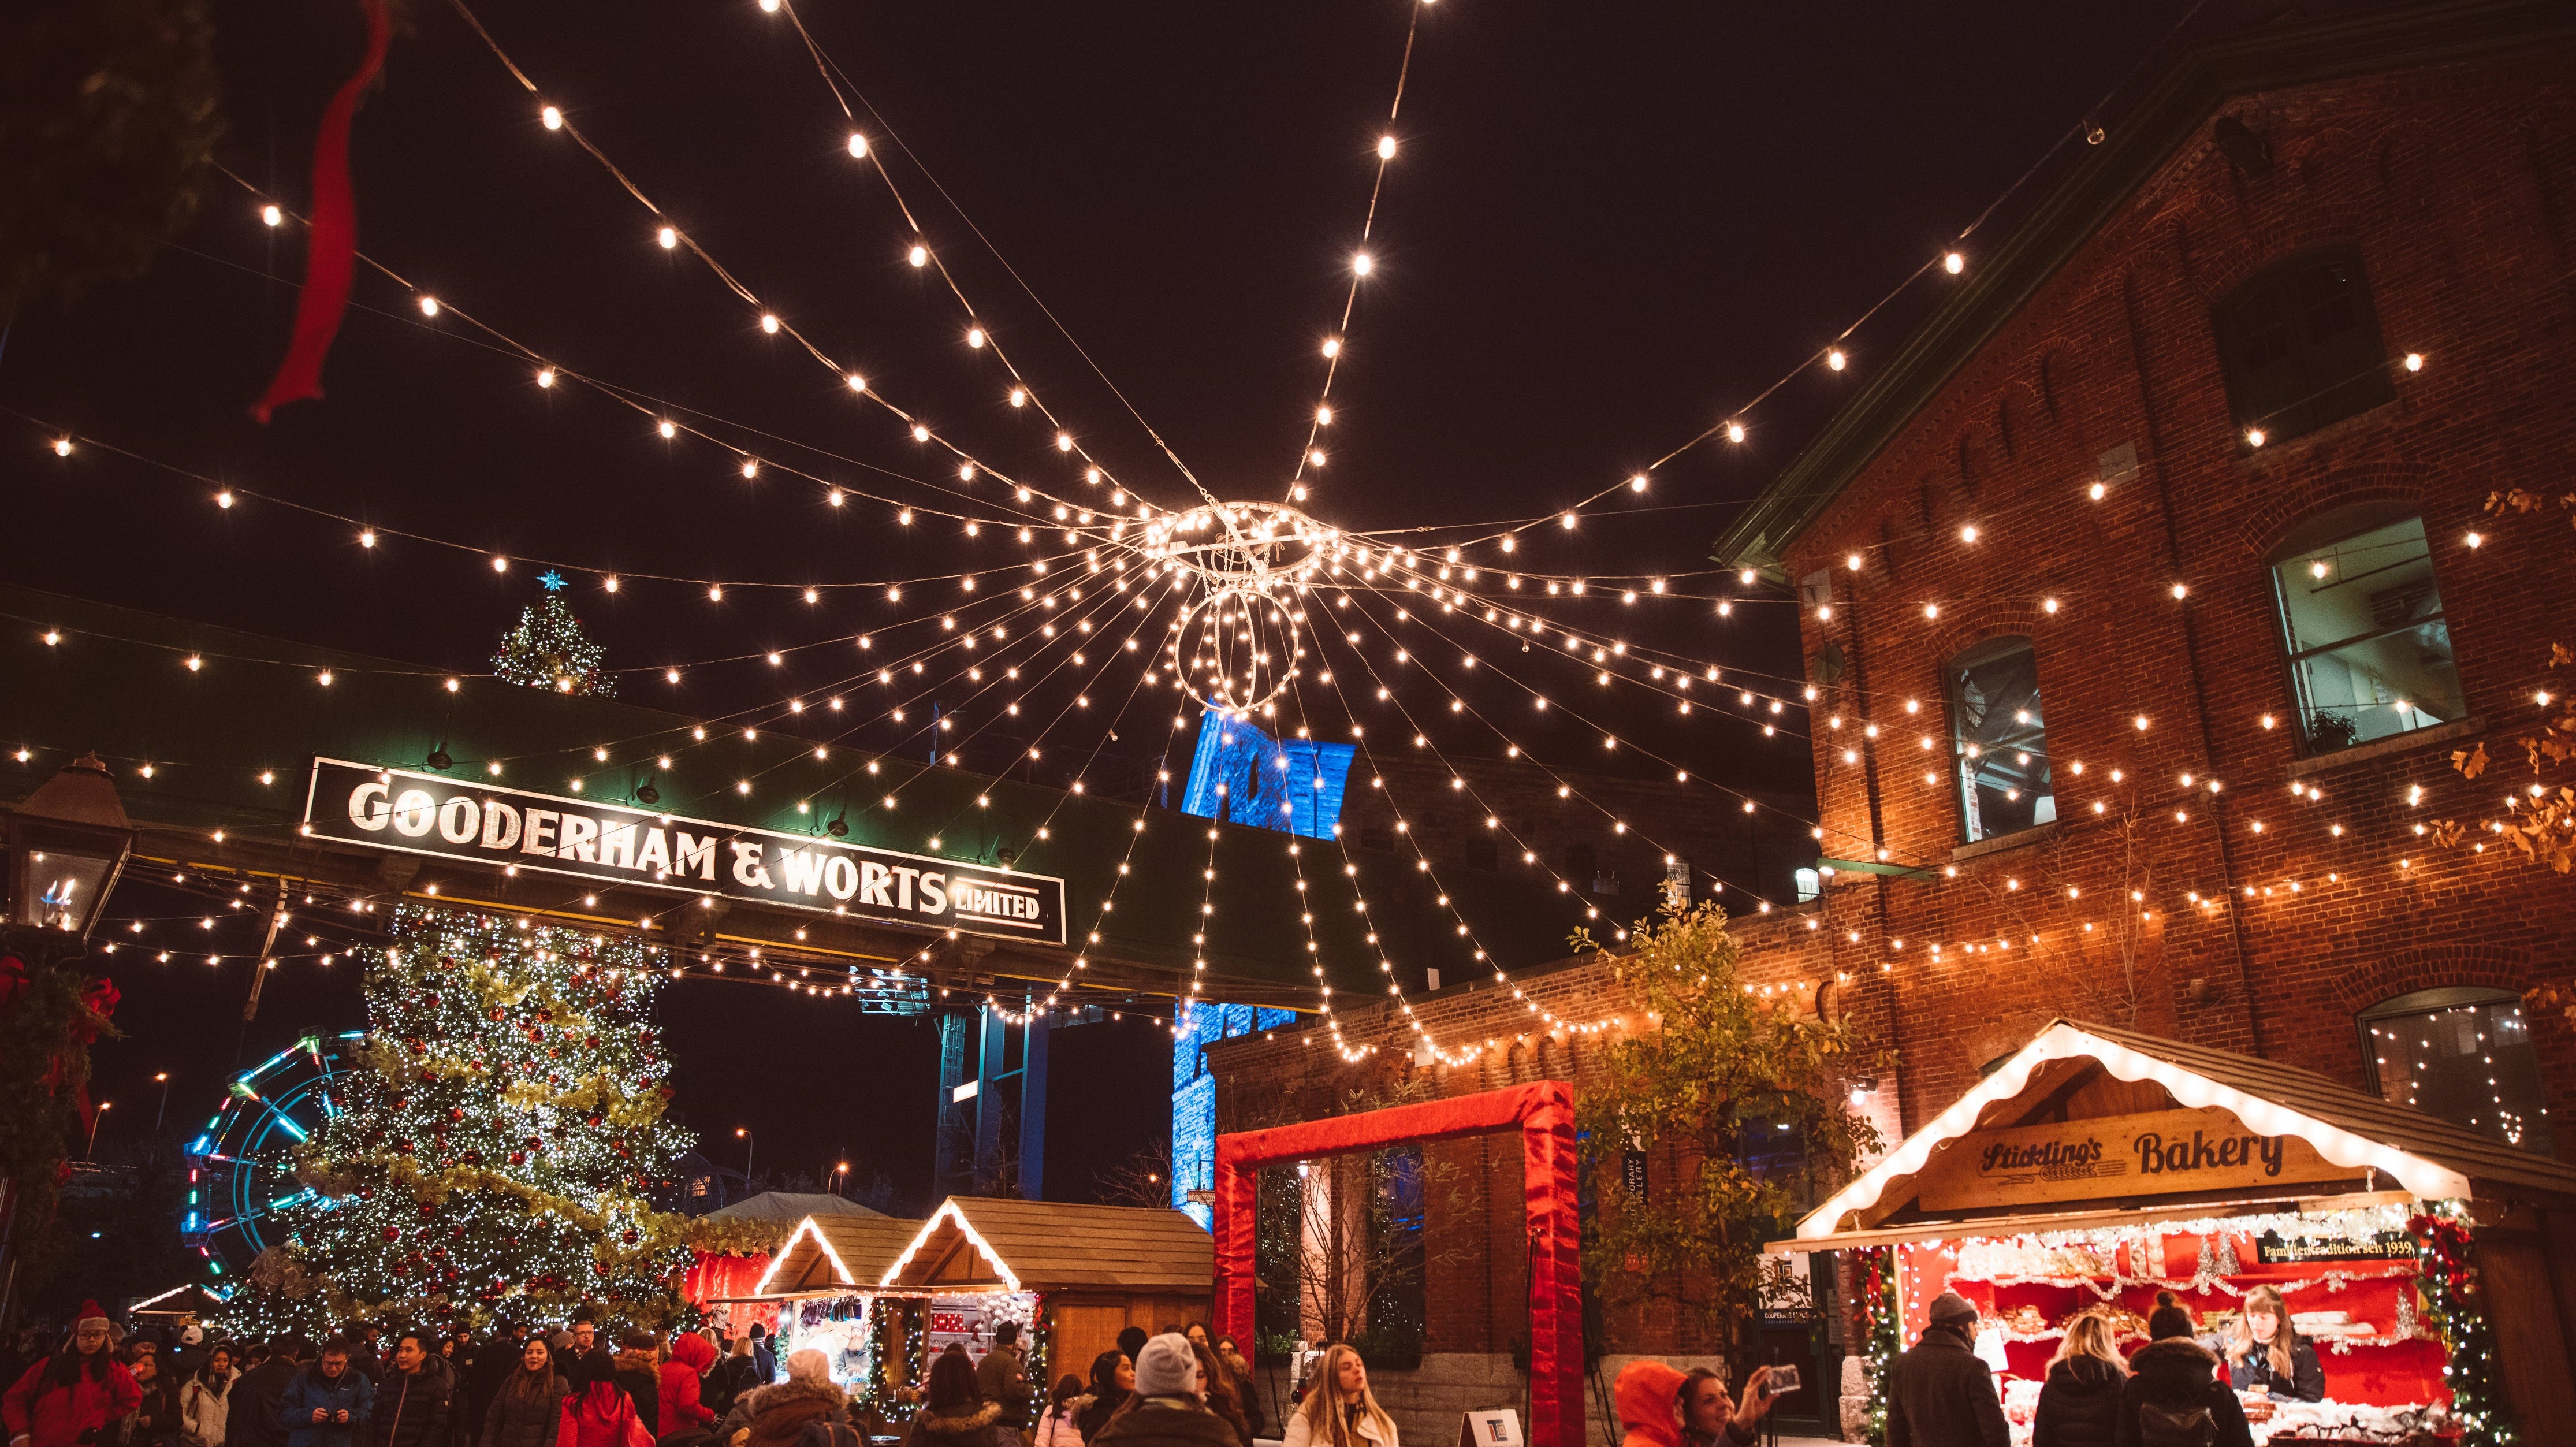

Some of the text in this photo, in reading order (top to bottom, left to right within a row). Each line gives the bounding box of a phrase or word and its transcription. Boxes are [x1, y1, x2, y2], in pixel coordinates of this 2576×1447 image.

[348, 782, 948, 916] GOODERHAM & WORTS
[955, 886, 1040, 920] LIMITED
[1982, 1130, 2283, 1177] Stickling's Bakery
[2264, 1241, 2413, 1257] Famiienrdition seit 1939
[1765, 1311, 1792, 1319] COOPERE
